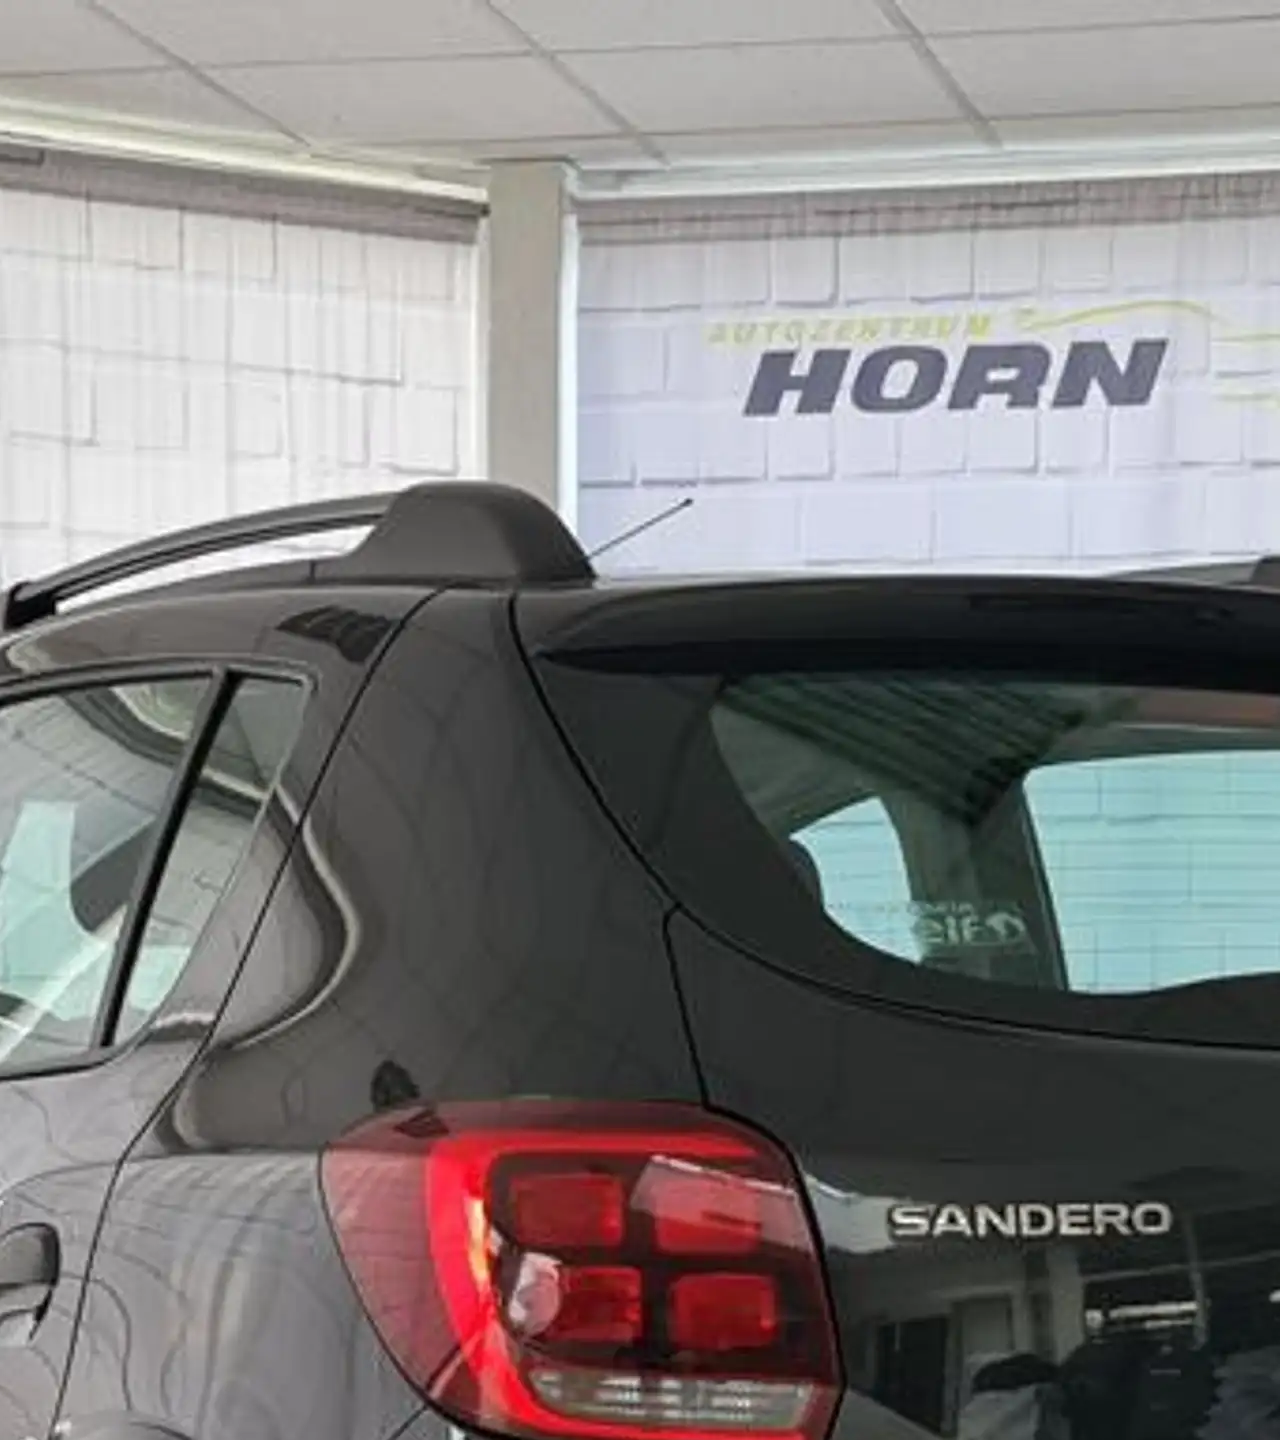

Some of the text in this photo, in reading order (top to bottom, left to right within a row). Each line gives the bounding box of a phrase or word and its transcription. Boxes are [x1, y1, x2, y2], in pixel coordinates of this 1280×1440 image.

[708, 314, 991, 344] AUTOZENTRUM
[743, 338, 1168, 417] HORN
[891, 1202, 1172, 1238] SANDERO
